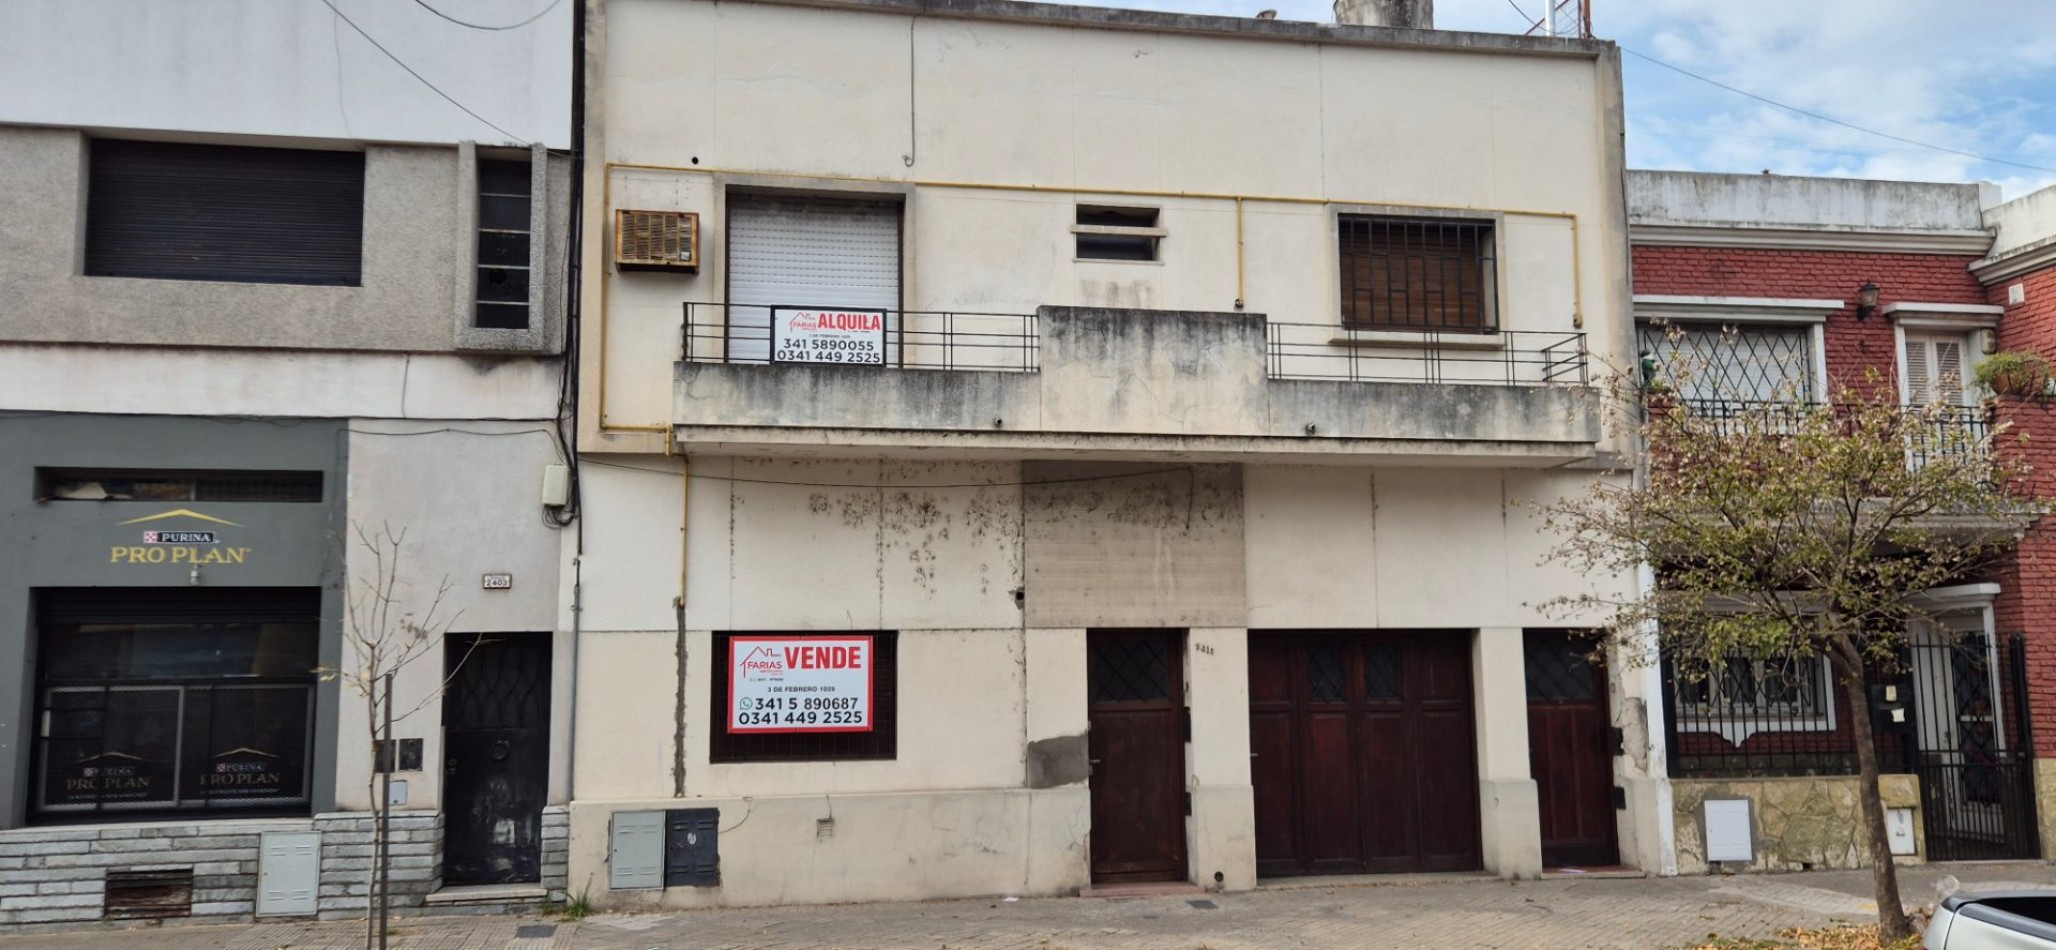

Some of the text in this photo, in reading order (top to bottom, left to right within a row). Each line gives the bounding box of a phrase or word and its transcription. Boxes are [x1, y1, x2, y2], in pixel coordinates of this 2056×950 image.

[818, 313, 881, 331] ALQUILA
[784, 339, 874, 351] 341 5890055
[777, 350, 880, 362] 0341 449 2525
[162, 533, 210, 542] PURINA
[110, 547, 245, 563] PRO PLAN
[748, 647, 861, 669] FARIAS VENDE
[755, 697, 858, 710] 341 5 890687
[739, 711, 862, 724] 0341 449 2525
[238, 773, 280, 784] PLAN
